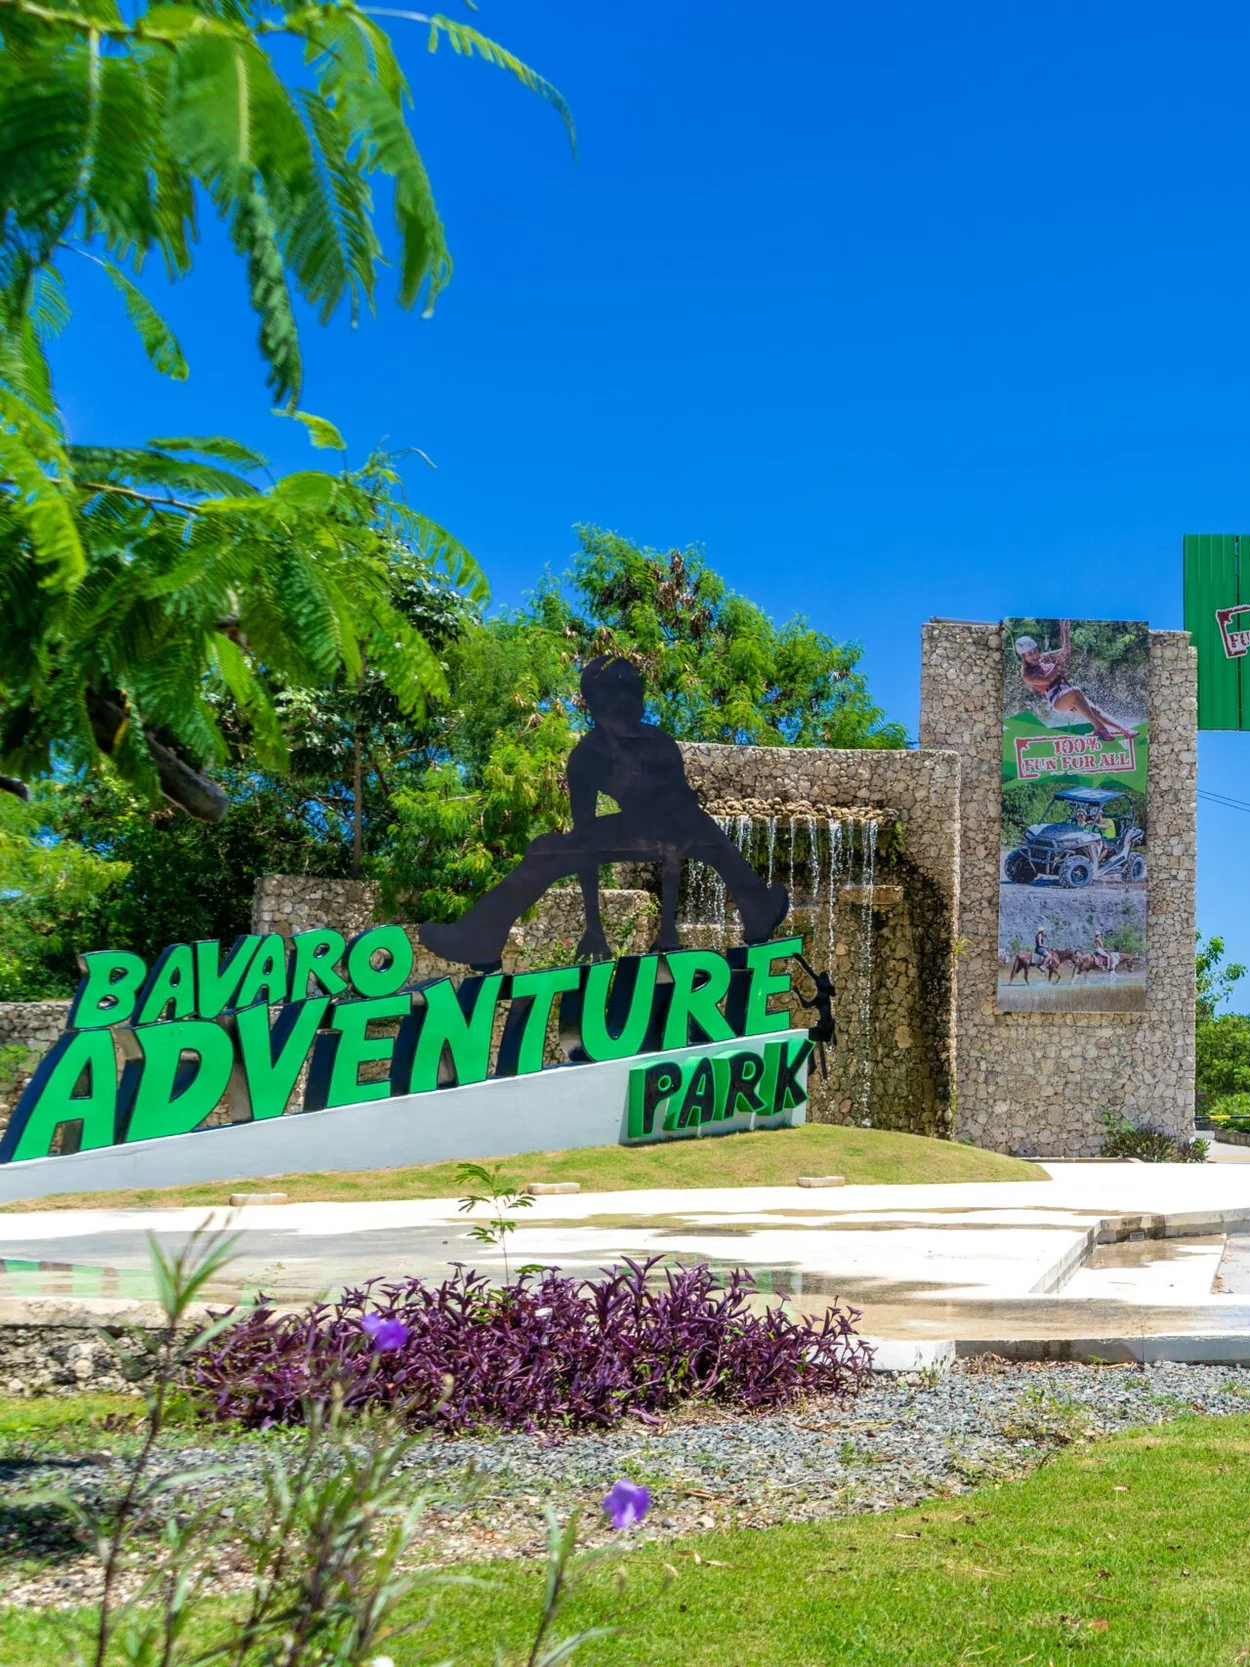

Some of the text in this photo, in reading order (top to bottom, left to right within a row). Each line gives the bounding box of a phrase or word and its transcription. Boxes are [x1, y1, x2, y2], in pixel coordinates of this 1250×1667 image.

[1023, 752, 1130, 772] FUN FOR ALL
[1054, 737, 1102, 756] 100%
[69, 924, 414, 1029] BAVARO
[4, 936, 803, 1164] ADVENTURE
[630, 1038, 816, 1138] PARK
